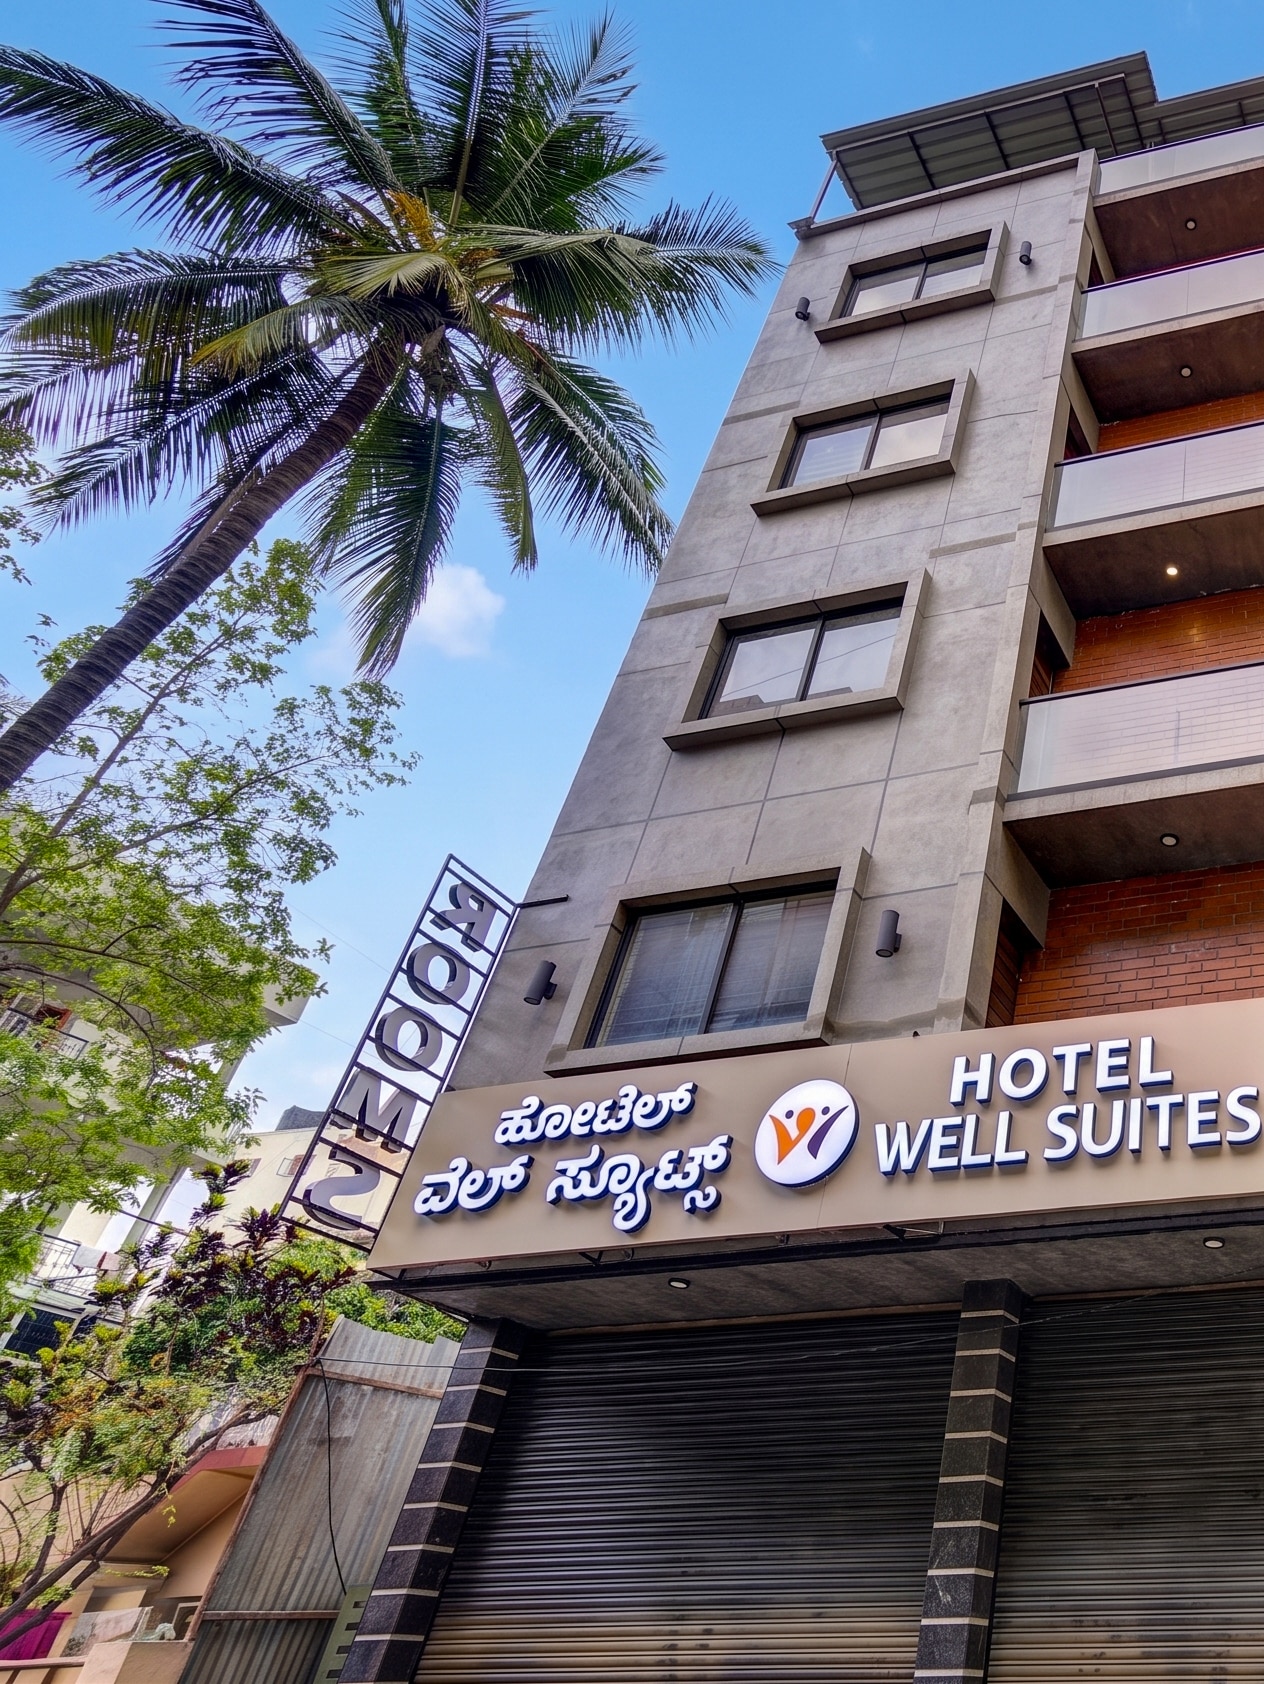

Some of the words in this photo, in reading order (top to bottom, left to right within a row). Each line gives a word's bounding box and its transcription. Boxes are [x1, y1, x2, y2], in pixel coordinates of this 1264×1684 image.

[949, 1036, 1173, 1107] HOTEL
[494, 1081, 698, 1147] ಹೋಟೆಲ್
[874, 1110, 1029, 1177] WELL
[1043, 1085, 1262, 1163] SUITES
[413, 1154, 535, 1216] ವೆಲ್
